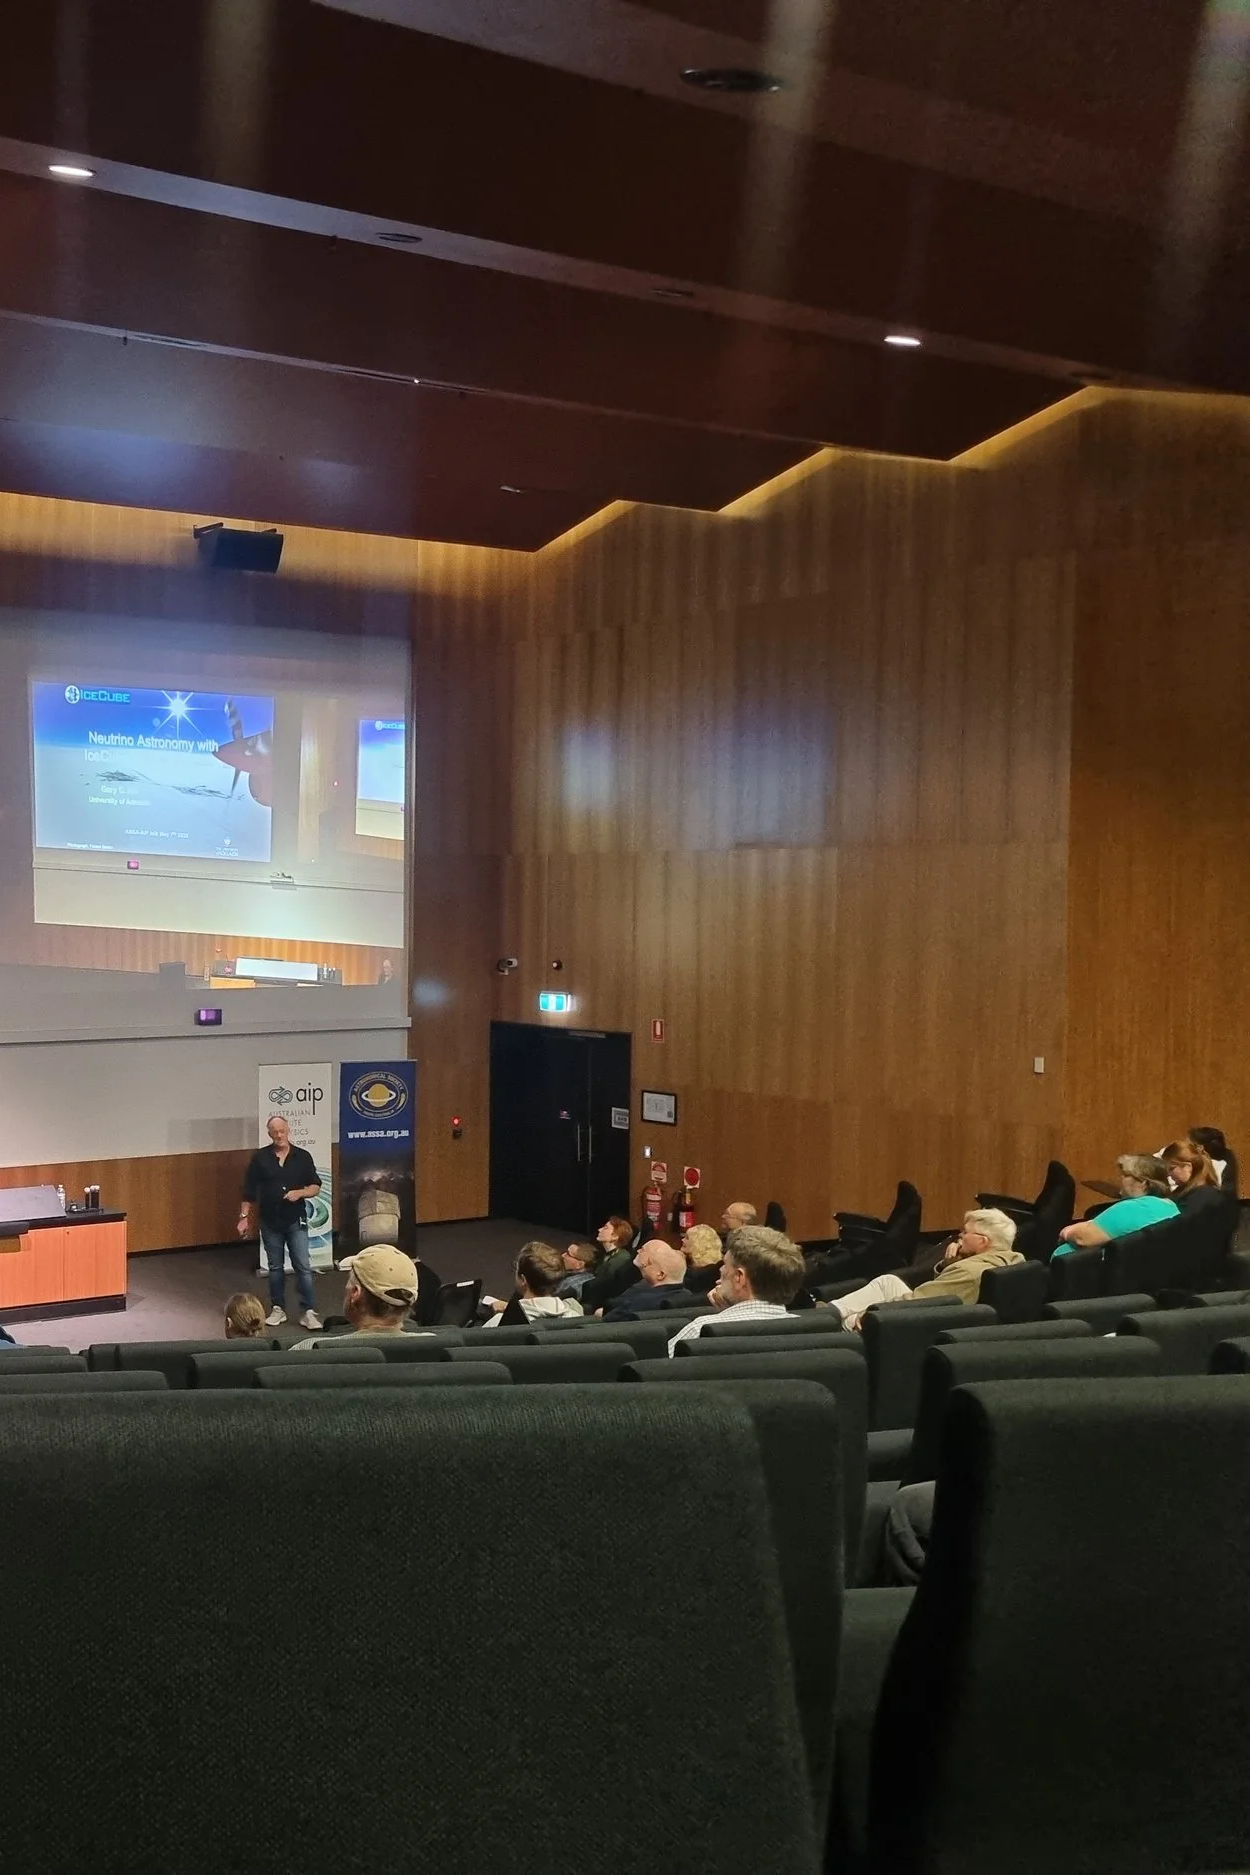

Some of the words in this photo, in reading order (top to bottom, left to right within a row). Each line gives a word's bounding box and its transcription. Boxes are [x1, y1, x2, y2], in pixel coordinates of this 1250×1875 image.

[88, 731, 135, 747] Neutrino
[137, 734, 195, 753] Astronomy
[196, 739, 219, 752] with
[296, 1082, 324, 1116] aip
[347, 1129, 410, 1139] www.assa.org.au
